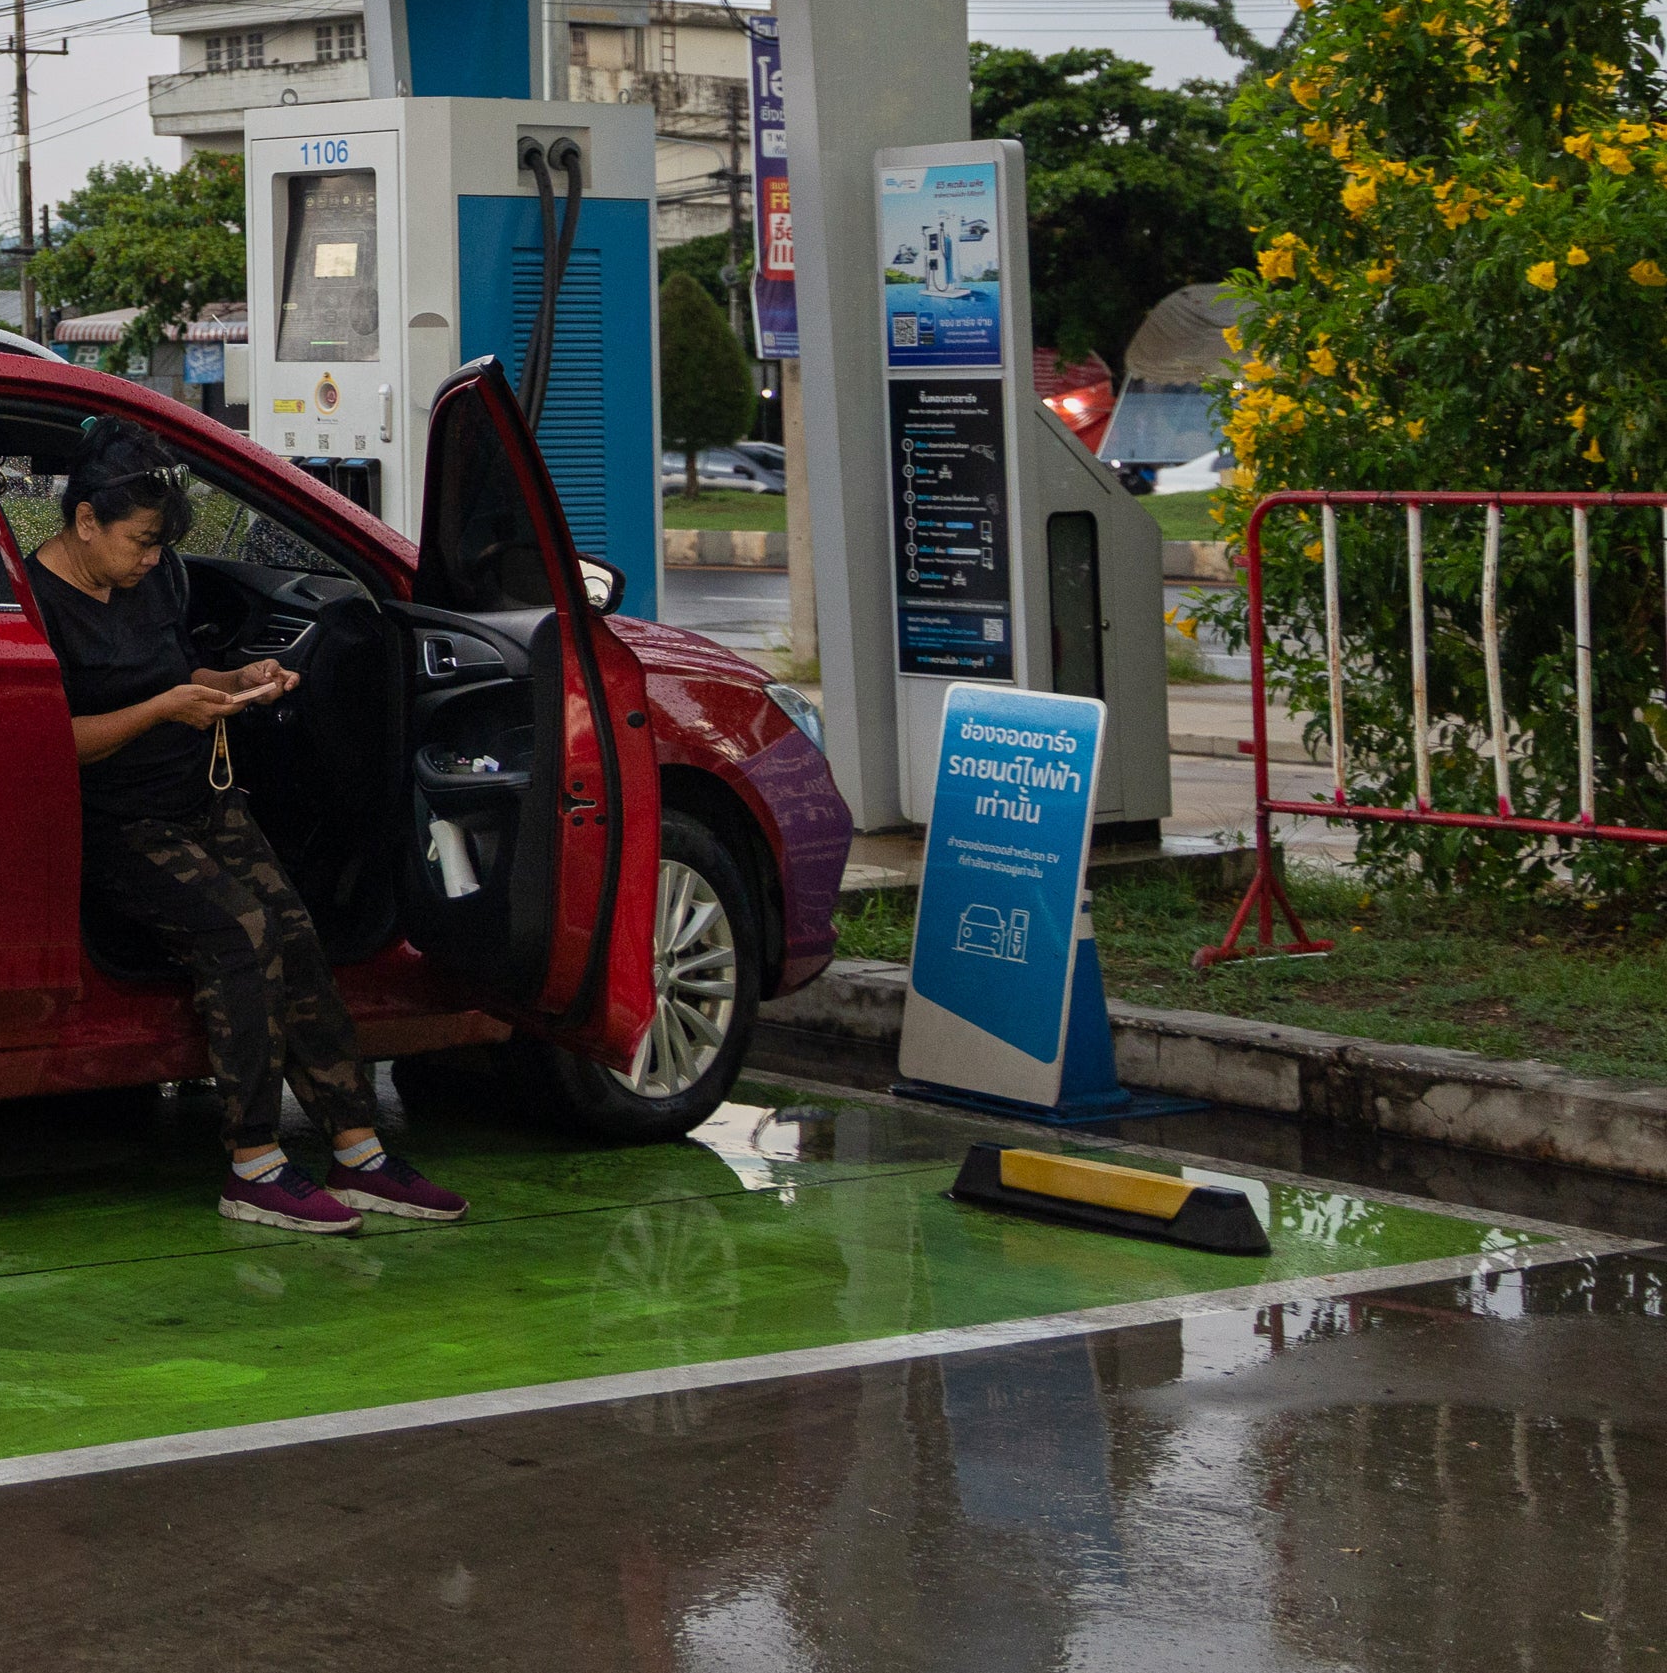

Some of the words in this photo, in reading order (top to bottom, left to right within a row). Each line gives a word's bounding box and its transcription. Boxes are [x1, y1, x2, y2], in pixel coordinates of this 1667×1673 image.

[300, 139, 349, 166] 1106
[960, 717, 1077, 754] ช่องจอดชาร์จ
[948, 754, 1081, 793] รถยนต์ไฟฟ้า
[975, 786, 1041, 824] เท่านั้น
[1046, 853, 1060, 864] EV
